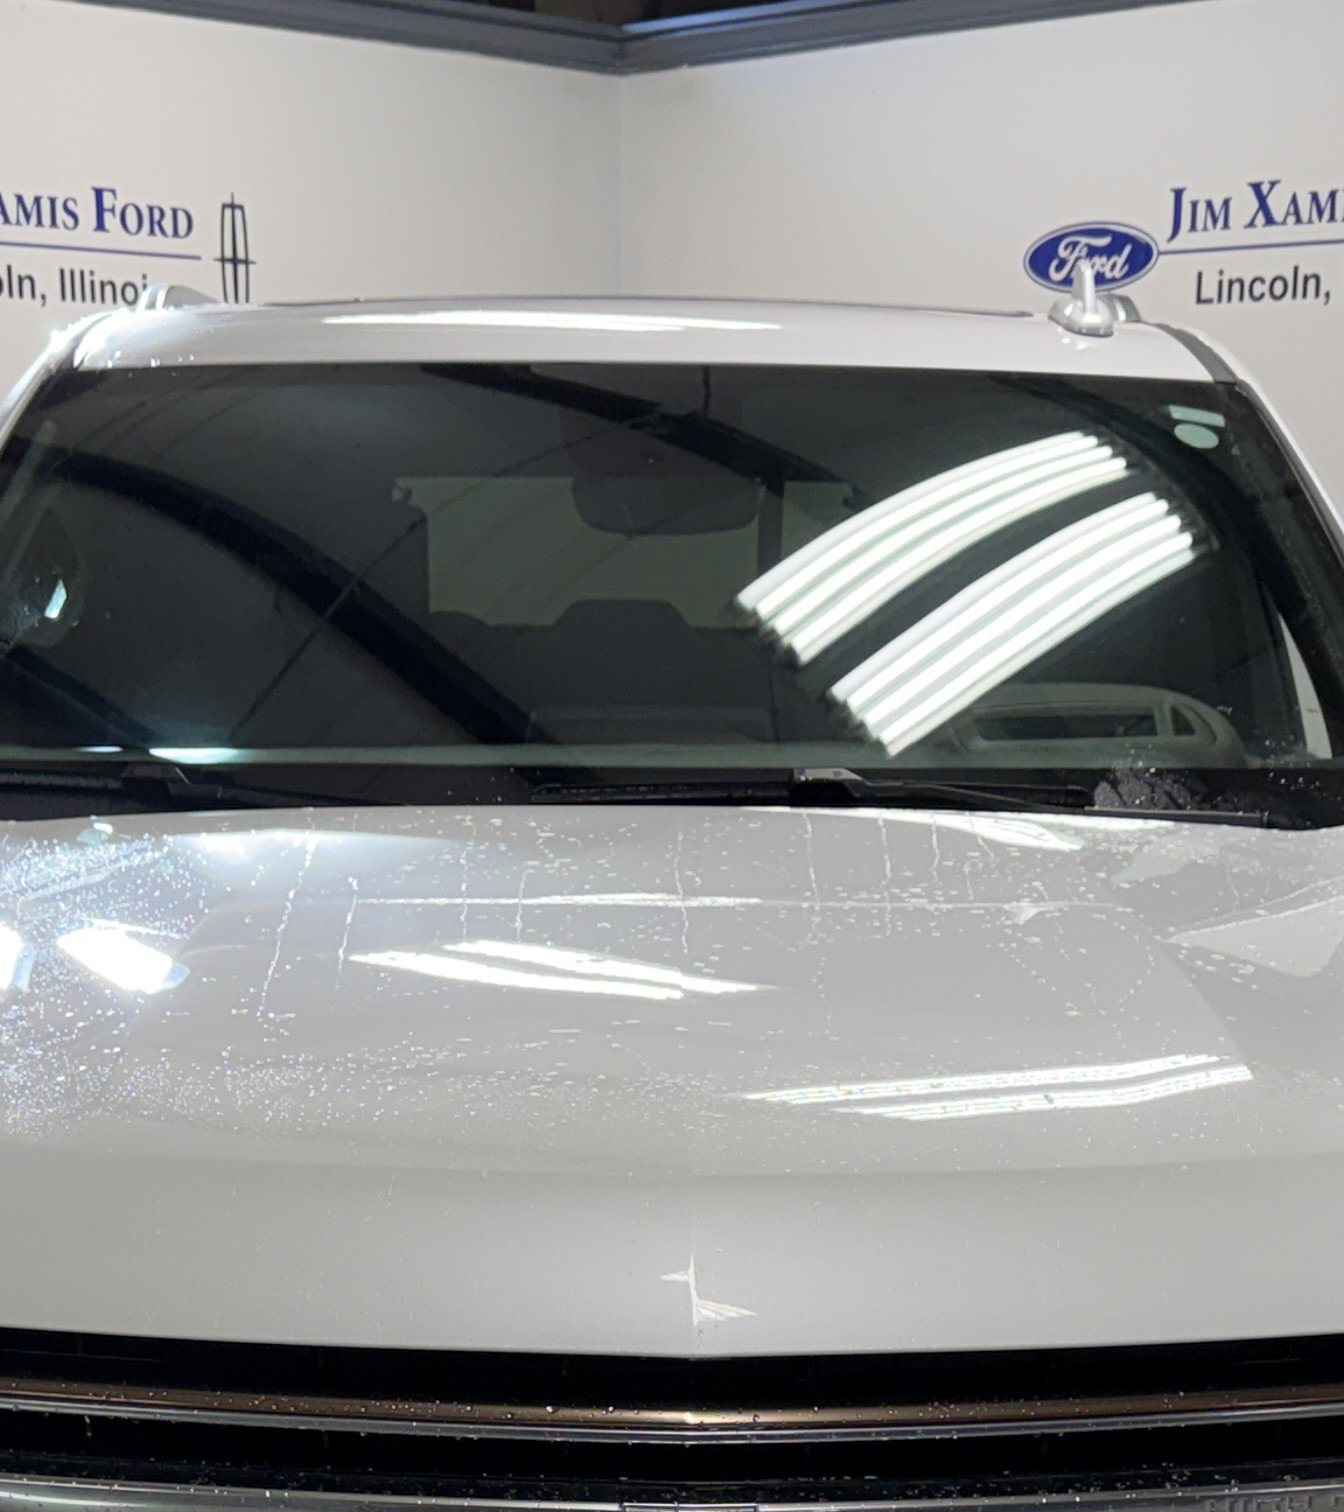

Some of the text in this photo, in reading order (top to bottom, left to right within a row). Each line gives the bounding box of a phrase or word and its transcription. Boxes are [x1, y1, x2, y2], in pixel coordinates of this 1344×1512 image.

[90, 186, 194, 240] FORD
[1167, 186, 1232, 242] JIM
[57, 267, 147, 307] Illinoi
[1195, 263, 1331, 306] Lincoln,
